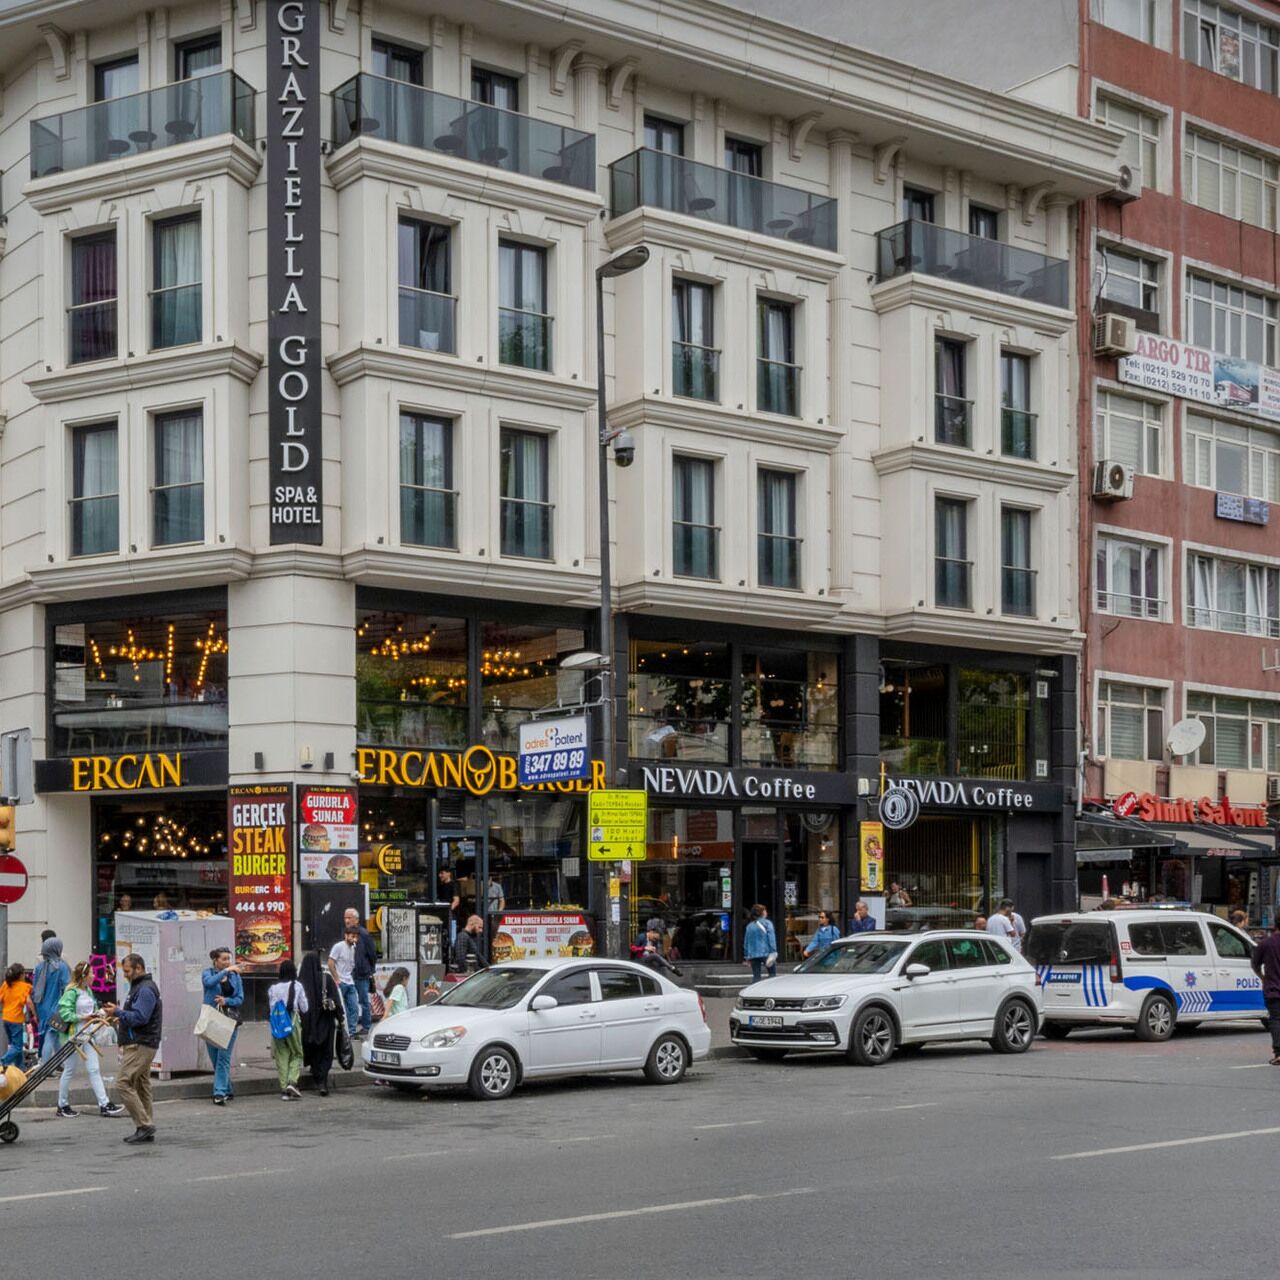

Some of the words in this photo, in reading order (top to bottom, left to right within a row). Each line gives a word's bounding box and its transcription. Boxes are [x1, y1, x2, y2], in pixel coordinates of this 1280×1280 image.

[277, 2, 309, 312] GRAZIELLA
[1136, 335, 1180, 366] ARGO
[1184, 347, 1211, 374] TIR
[1142, 362, 1169, 379] (0212)
[1170, 370, 1186, 381] 529
[1188, 374, 1199, 385] 70
[1200, 377, 1210, 388] 70
[1142, 375, 1169, 391] (0212)
[1171, 383, 1187, 394] 529
[1189, 387, 1199, 398] 11
[1201, 390, 1210, 401] 10
[278, 336, 309, 472] GOLD
[275, 486, 305, 503] SPA
[307, 486, 317, 503] &
[272, 506, 321, 524] HOTEL
[525, 736, 549, 750] adres
[554, 732, 583, 748] patent
[71, 752, 182, 791] ERCAN
[358, 748, 462, 788] ERCAN
[531, 754, 552, 774] 347
[553, 751, 568, 771] 89
[569, 749, 584, 768] 89
[261, 786, 288, 794] BURGER
[642, 767, 739, 796] NEVADA
[744, 776, 816, 799] Coffee
[307, 795, 350, 809] GURURLA
[973, 786, 1033, 808] Coffee
[1139, 793, 1197, 824] Simit
[232, 802, 286, 831] GERÇEK
[312, 810, 344, 823] SUNAR
[233, 827, 286, 854] STEAK
[233, 854, 286, 876] BURGER
[236, 902, 256, 912] 444
[258, 902, 265, 912] 4
[266, 901, 285, 912] 990
